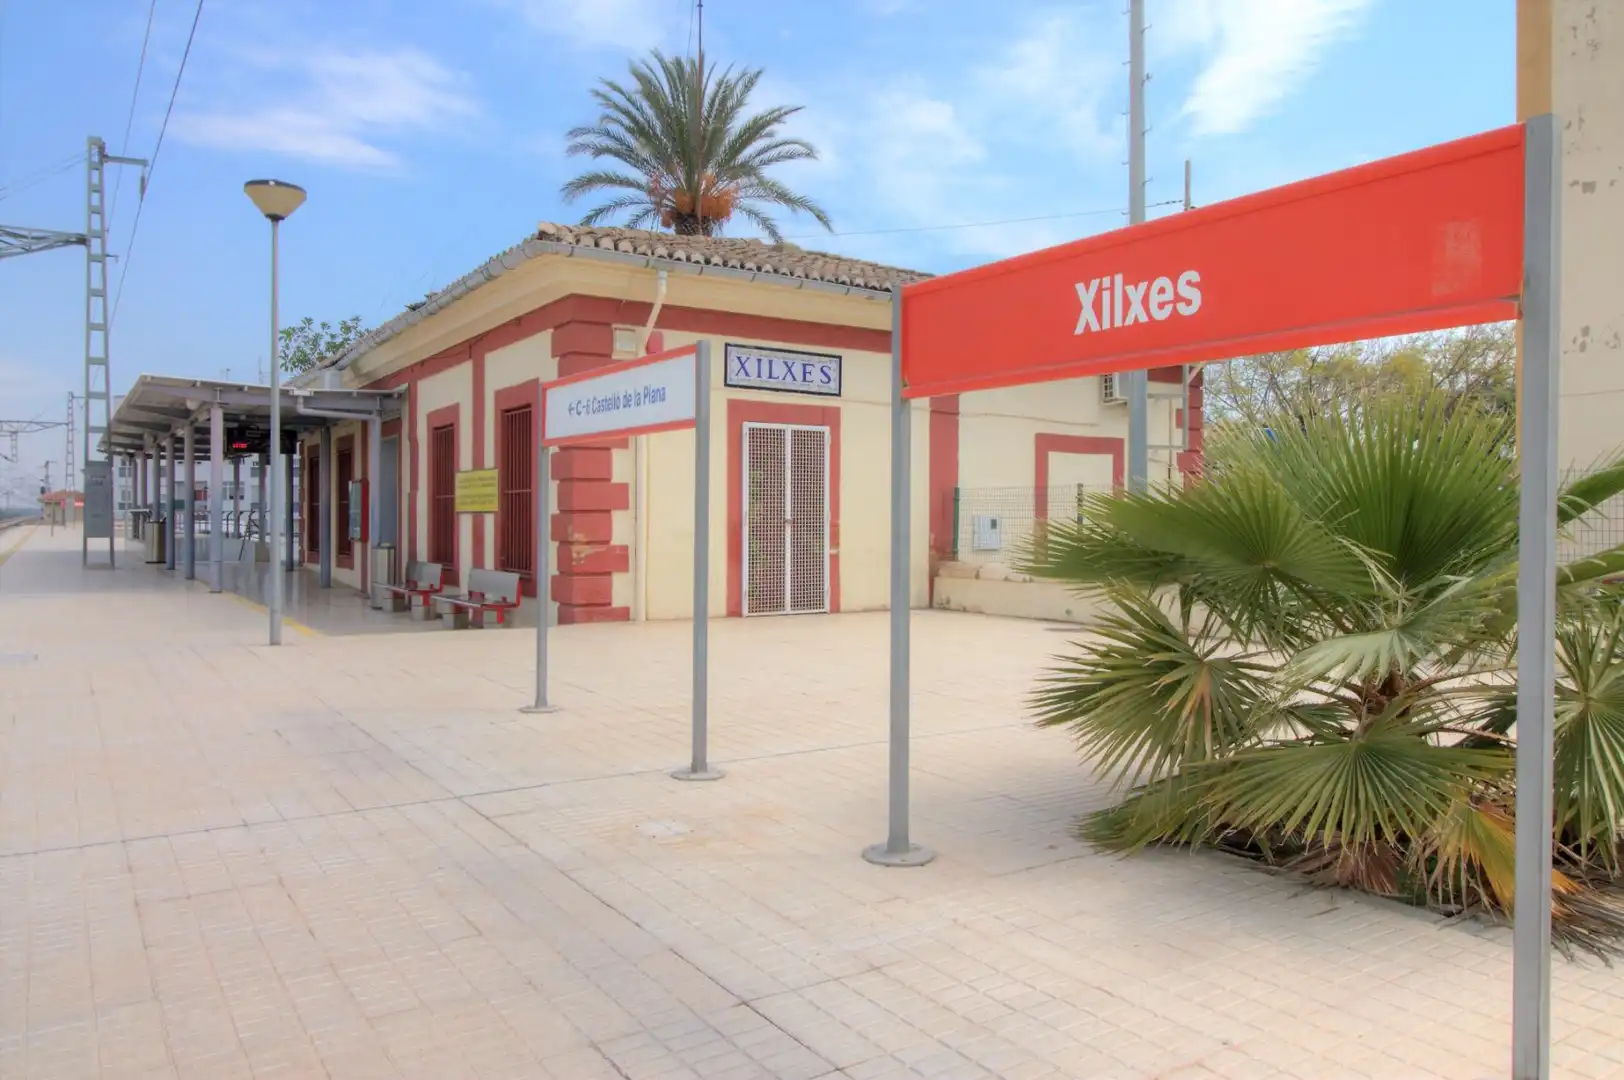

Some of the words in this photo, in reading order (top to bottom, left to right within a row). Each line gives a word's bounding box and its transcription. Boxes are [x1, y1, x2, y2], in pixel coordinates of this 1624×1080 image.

[1074, 269, 1202, 335] Xilxes
[735, 355, 832, 385] XILXES
[576, 398, 590, 416] C-6
[622, 389, 632, 409] de
[633, 386, 641, 407] la
[643, 384, 666, 405] Plana
